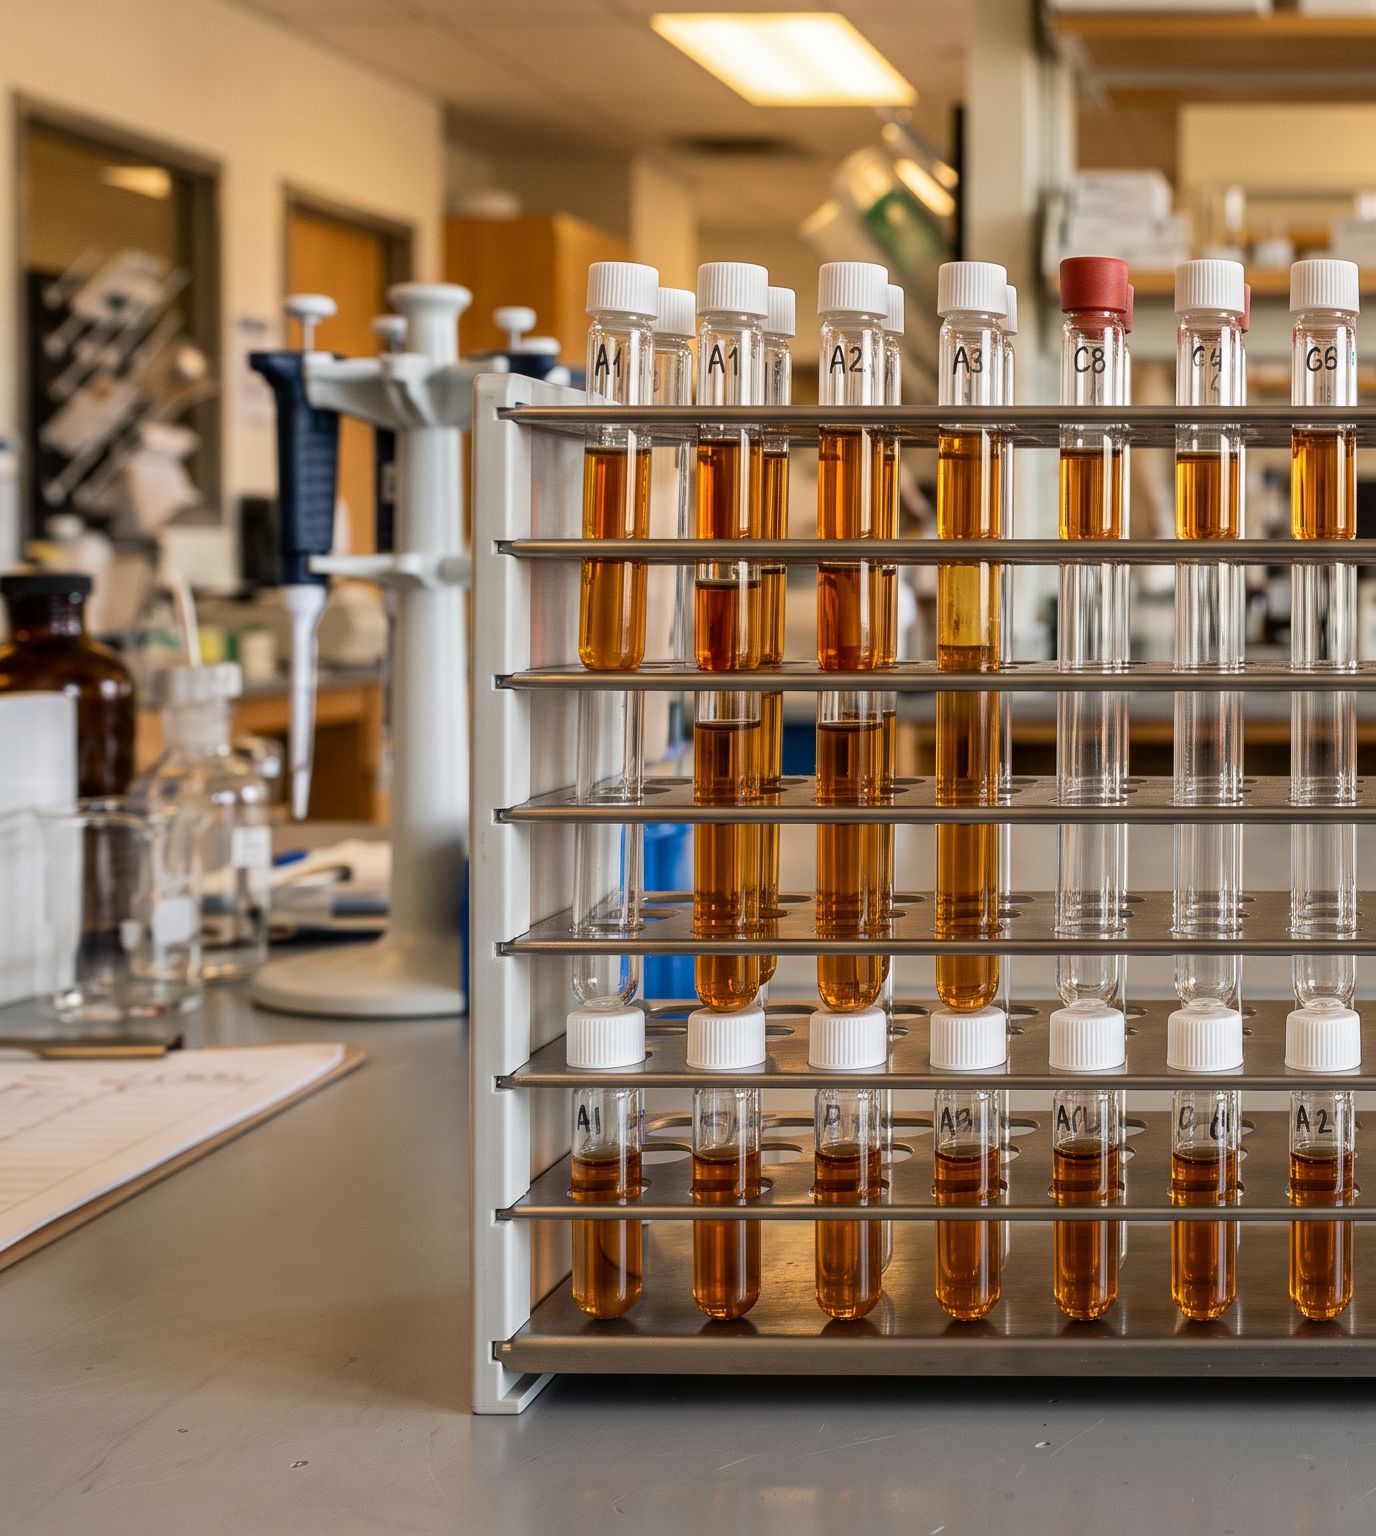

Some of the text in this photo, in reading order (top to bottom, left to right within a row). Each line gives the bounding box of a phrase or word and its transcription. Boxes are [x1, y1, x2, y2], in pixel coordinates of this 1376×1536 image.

[595, 343, 622, 377] A1
[708, 343, 738, 376] A1
[829, 344, 867, 374] A2
[952, 346, 984, 375] A3
[1296, 1104, 1333, 1135] A2
